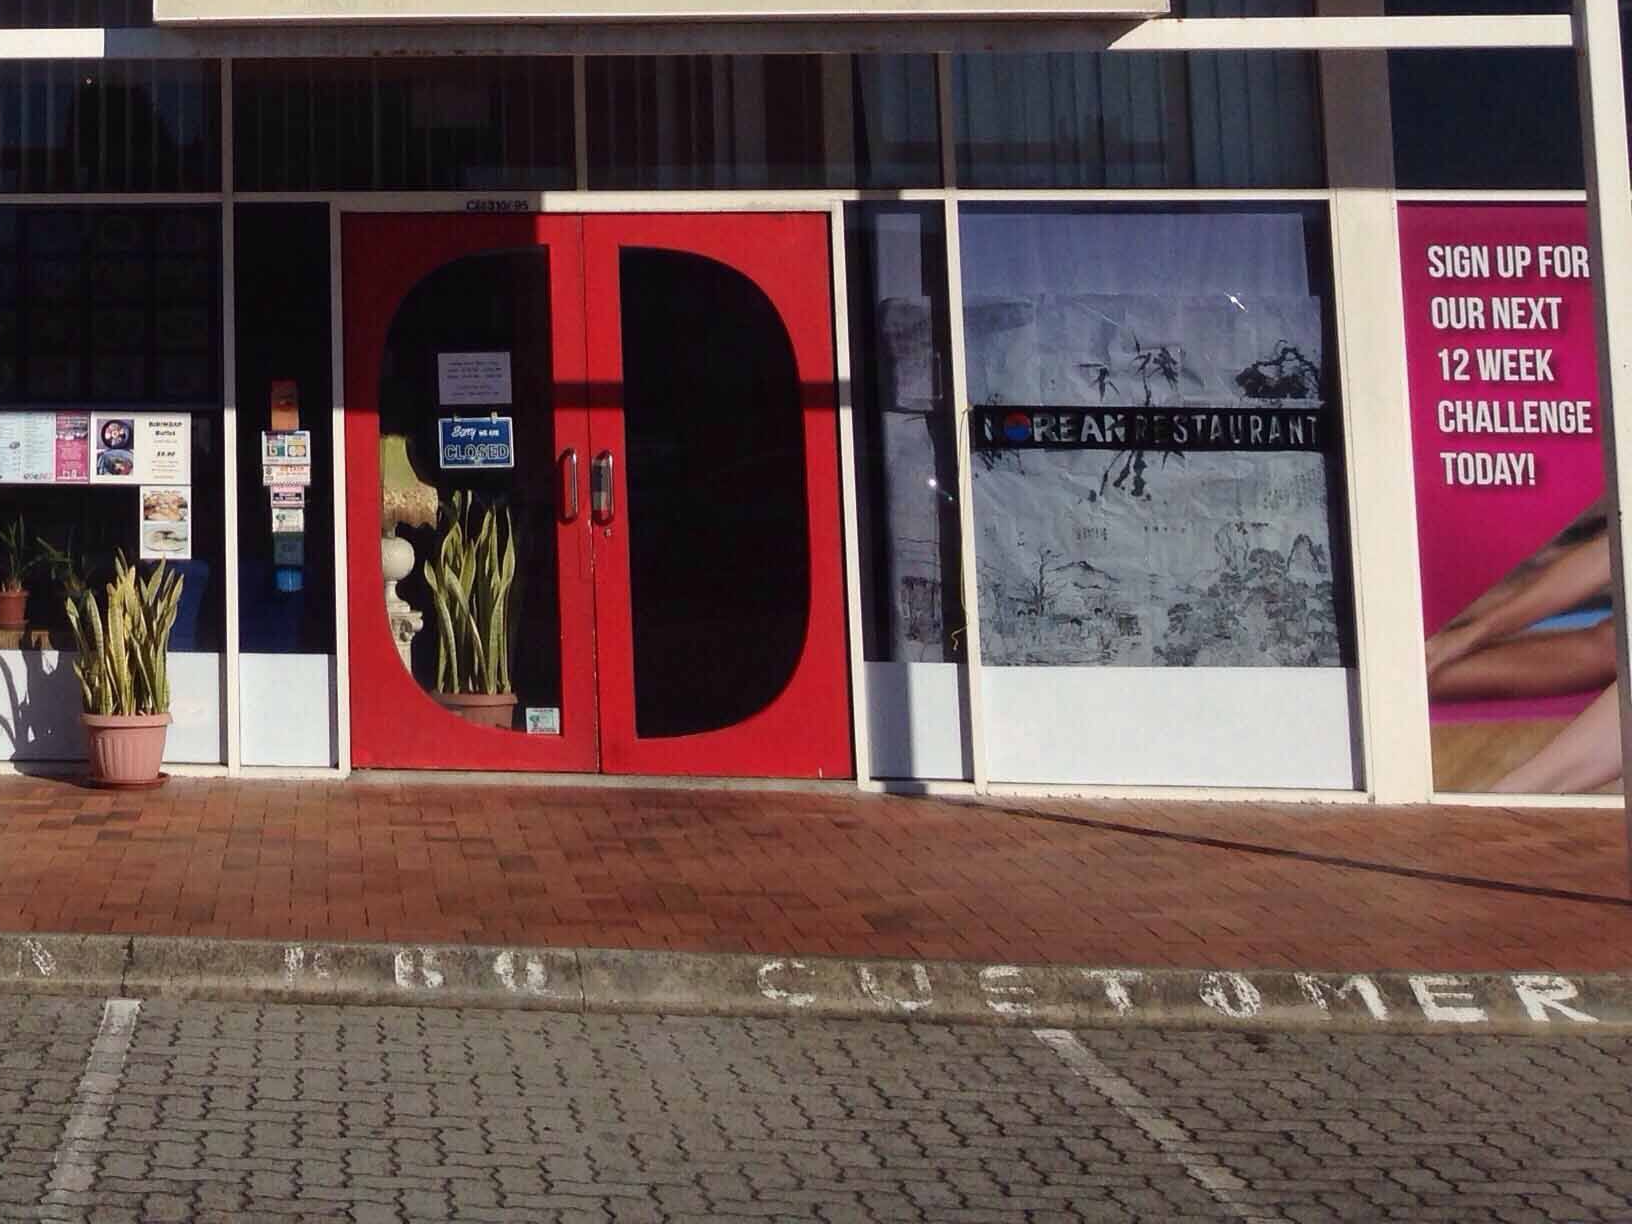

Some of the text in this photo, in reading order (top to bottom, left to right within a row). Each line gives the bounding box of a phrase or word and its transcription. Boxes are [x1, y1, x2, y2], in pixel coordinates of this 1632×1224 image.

[1427, 245, 1590, 278] SIGN UP FOR
[1431, 297, 1562, 329] OUR NEXT
[1438, 348, 1555, 381] 12 WEEK
[451, 425, 477, 441] Sorry
[1134, 414, 1318, 445] RESTAURANT
[1438, 400, 1593, 434] CHALLENGE
[444, 443, 510, 461] CLOSED
[1440, 452, 1536, 485] TODAY!
